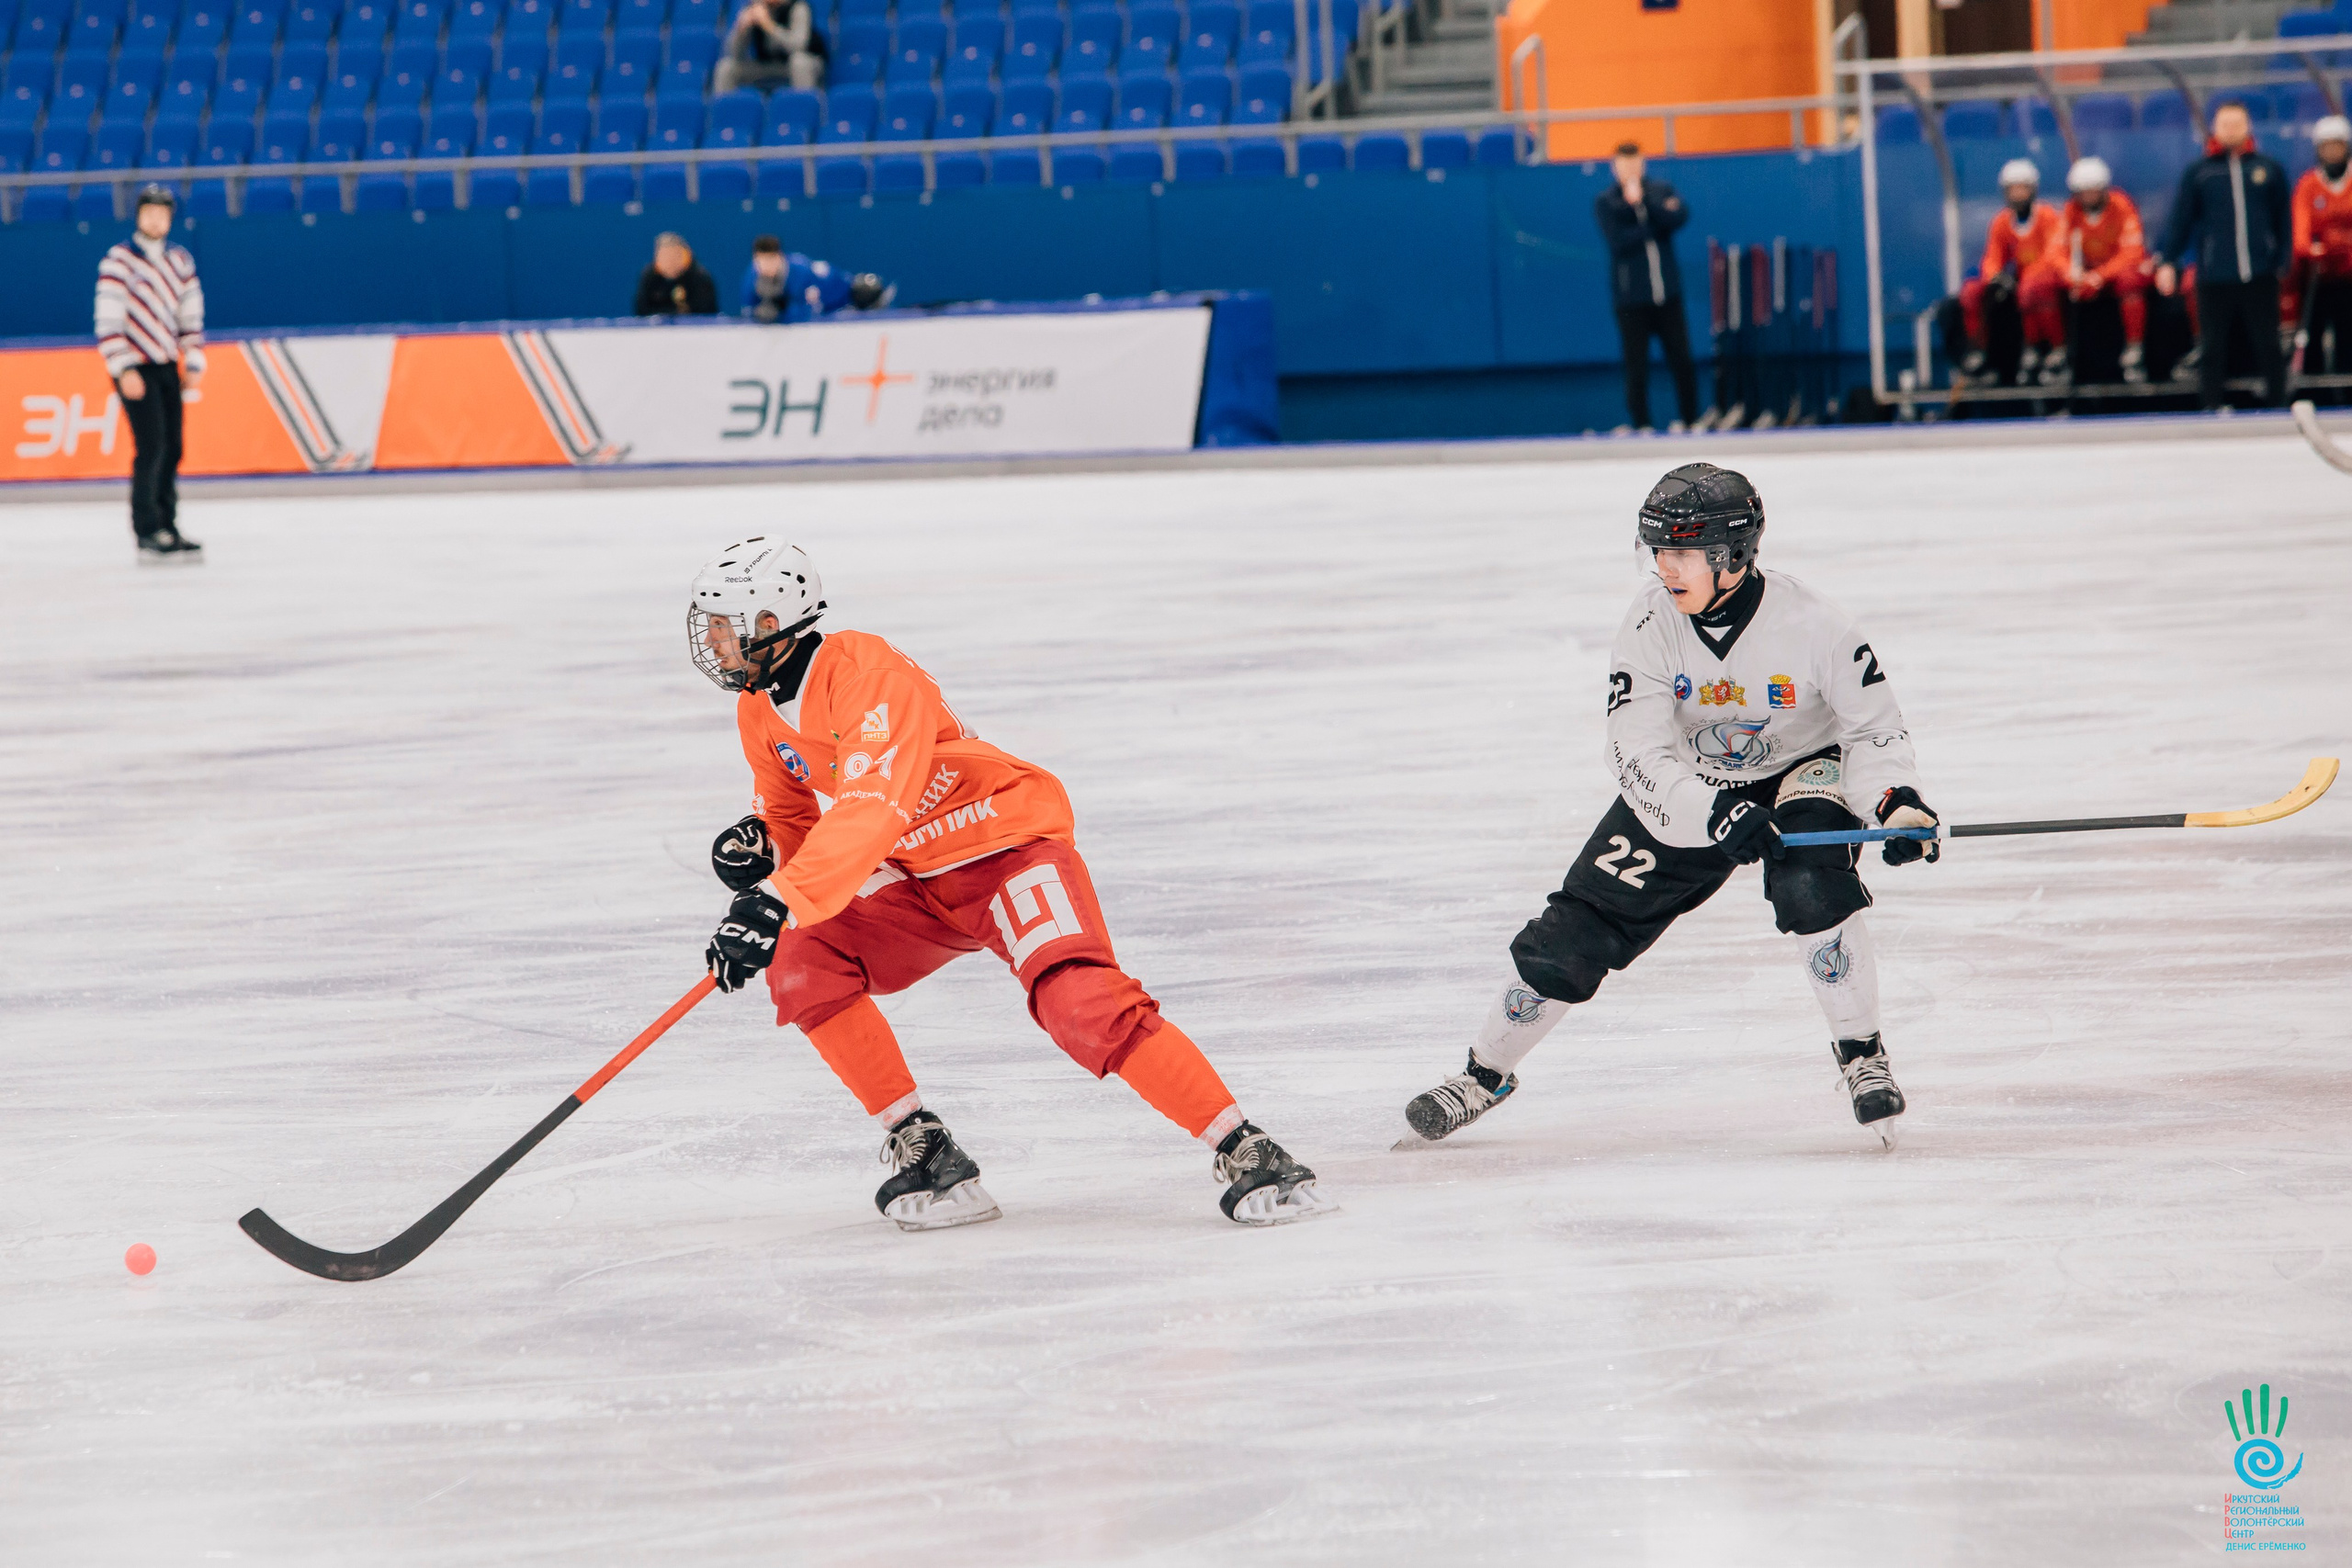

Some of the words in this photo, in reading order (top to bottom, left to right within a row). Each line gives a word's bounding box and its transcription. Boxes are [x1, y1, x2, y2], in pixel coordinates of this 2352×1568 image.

[1641, 516, 1664, 529] CCM
[1727, 518, 1748, 527] CCM
[863, 732, 888, 741] ПНТЗ
[840, 789, 887, 803] АКАДЕМИЯ
[1594, 834, 1657, 890] 22
[715, 922, 776, 951] CM
